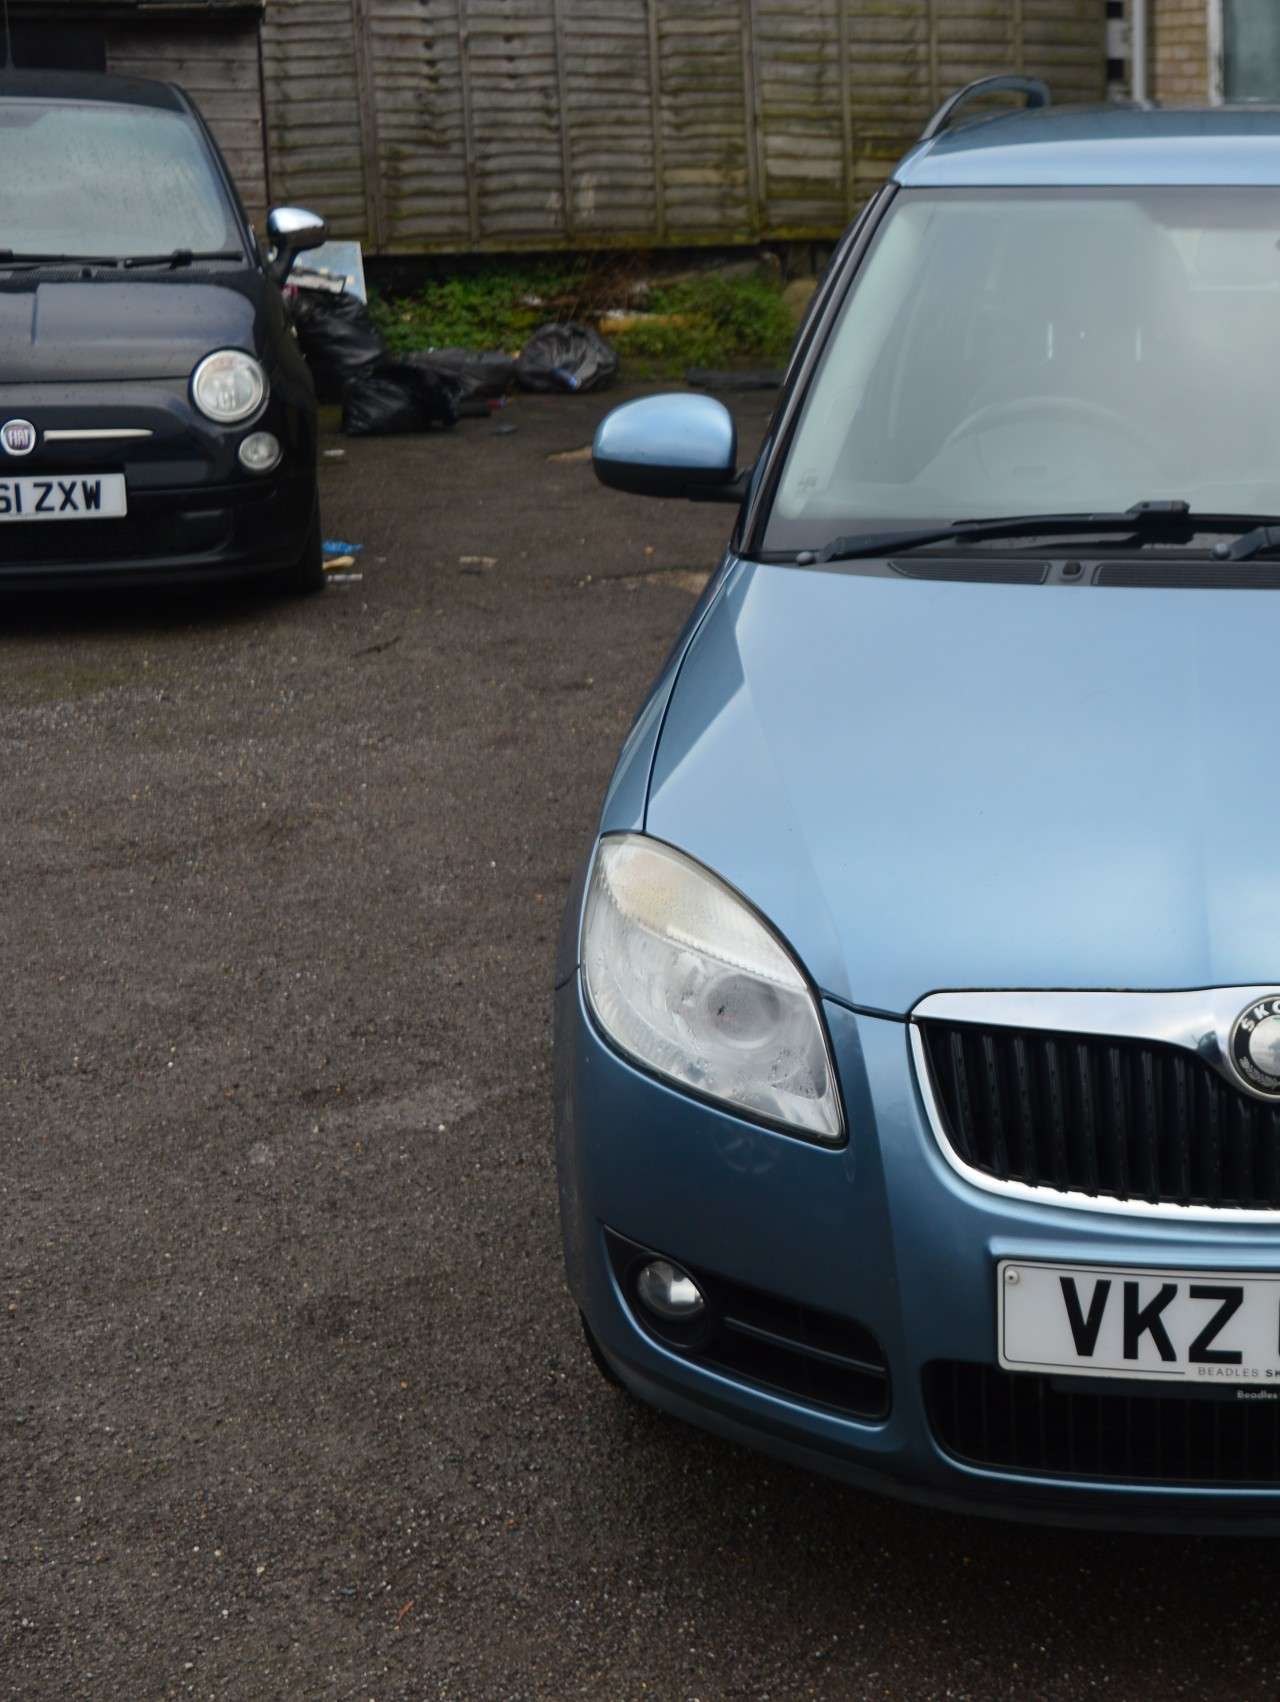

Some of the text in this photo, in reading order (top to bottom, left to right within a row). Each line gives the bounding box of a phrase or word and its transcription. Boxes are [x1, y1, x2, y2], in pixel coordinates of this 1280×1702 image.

[8, 429, 29, 448] FIAT
[33, 479, 101, 512] ZXW
[1059, 1276, 1244, 1364] VKZ
[1198, 1366, 1259, 1377] BEADLES
[1236, 1389, 1278, 1399] Beadles
